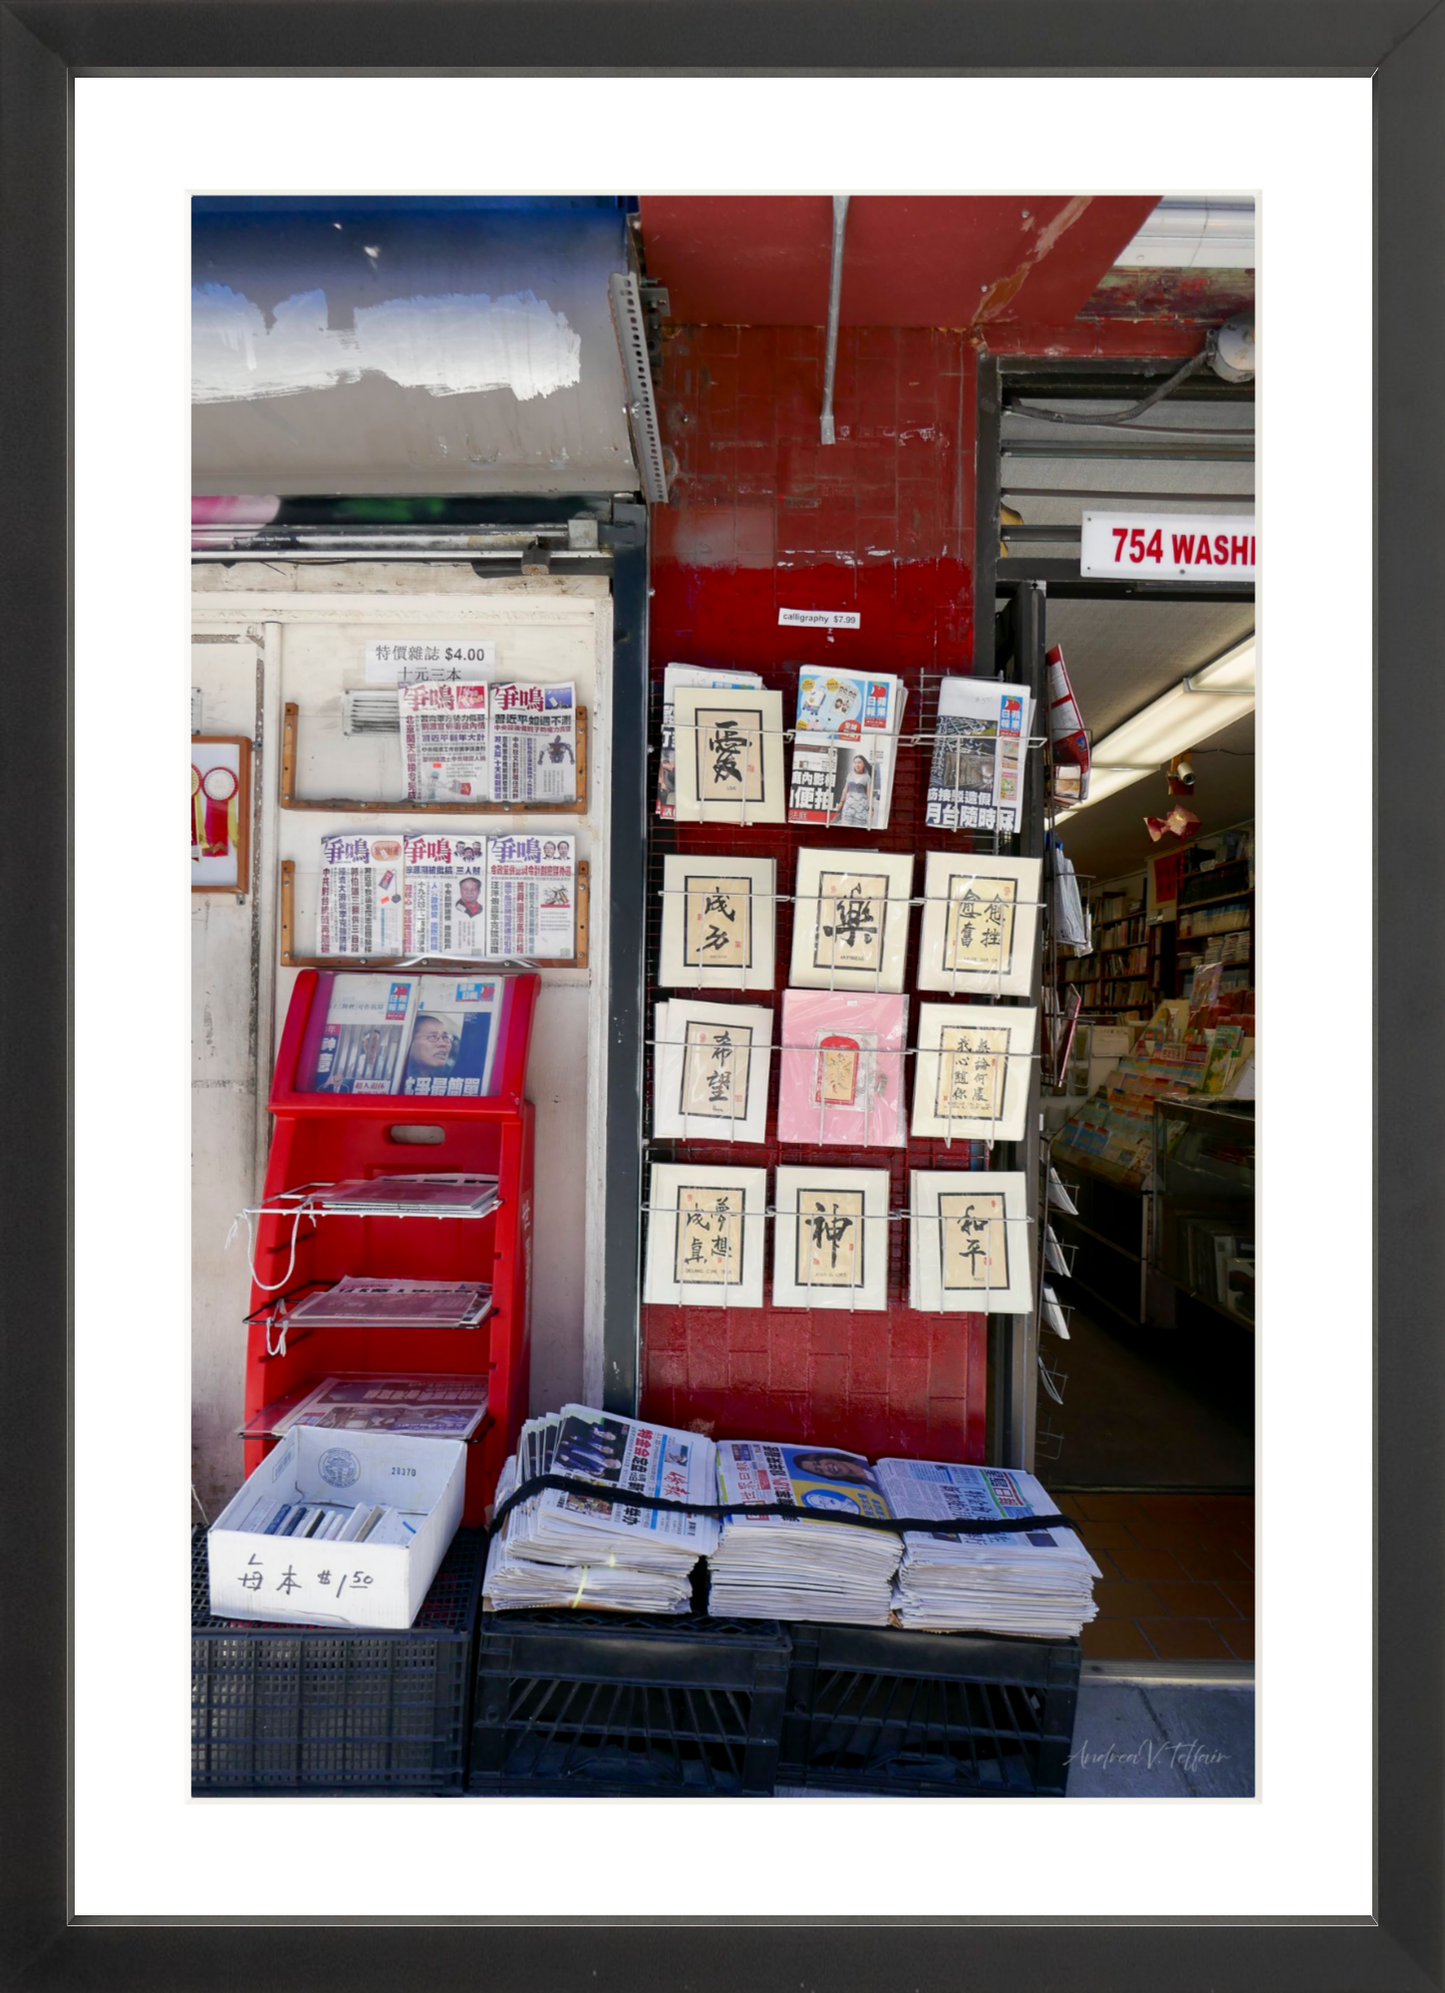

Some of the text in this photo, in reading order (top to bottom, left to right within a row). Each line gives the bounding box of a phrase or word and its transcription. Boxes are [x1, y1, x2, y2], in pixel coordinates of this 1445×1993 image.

[1112, 527, 1164, 564] 754
[782, 613, 857, 624] calligraphy $7.99
[375, 644, 485, 661] 特價雜誌 $4.00
[397, 666, 462, 681] 十元三本
[494, 684, 544, 713] 爭鳴
[323, 838, 371, 864] 爭鳴
[403, 837, 452, 864] 爭鳴
[491, 837, 542, 864] 爭鳴
